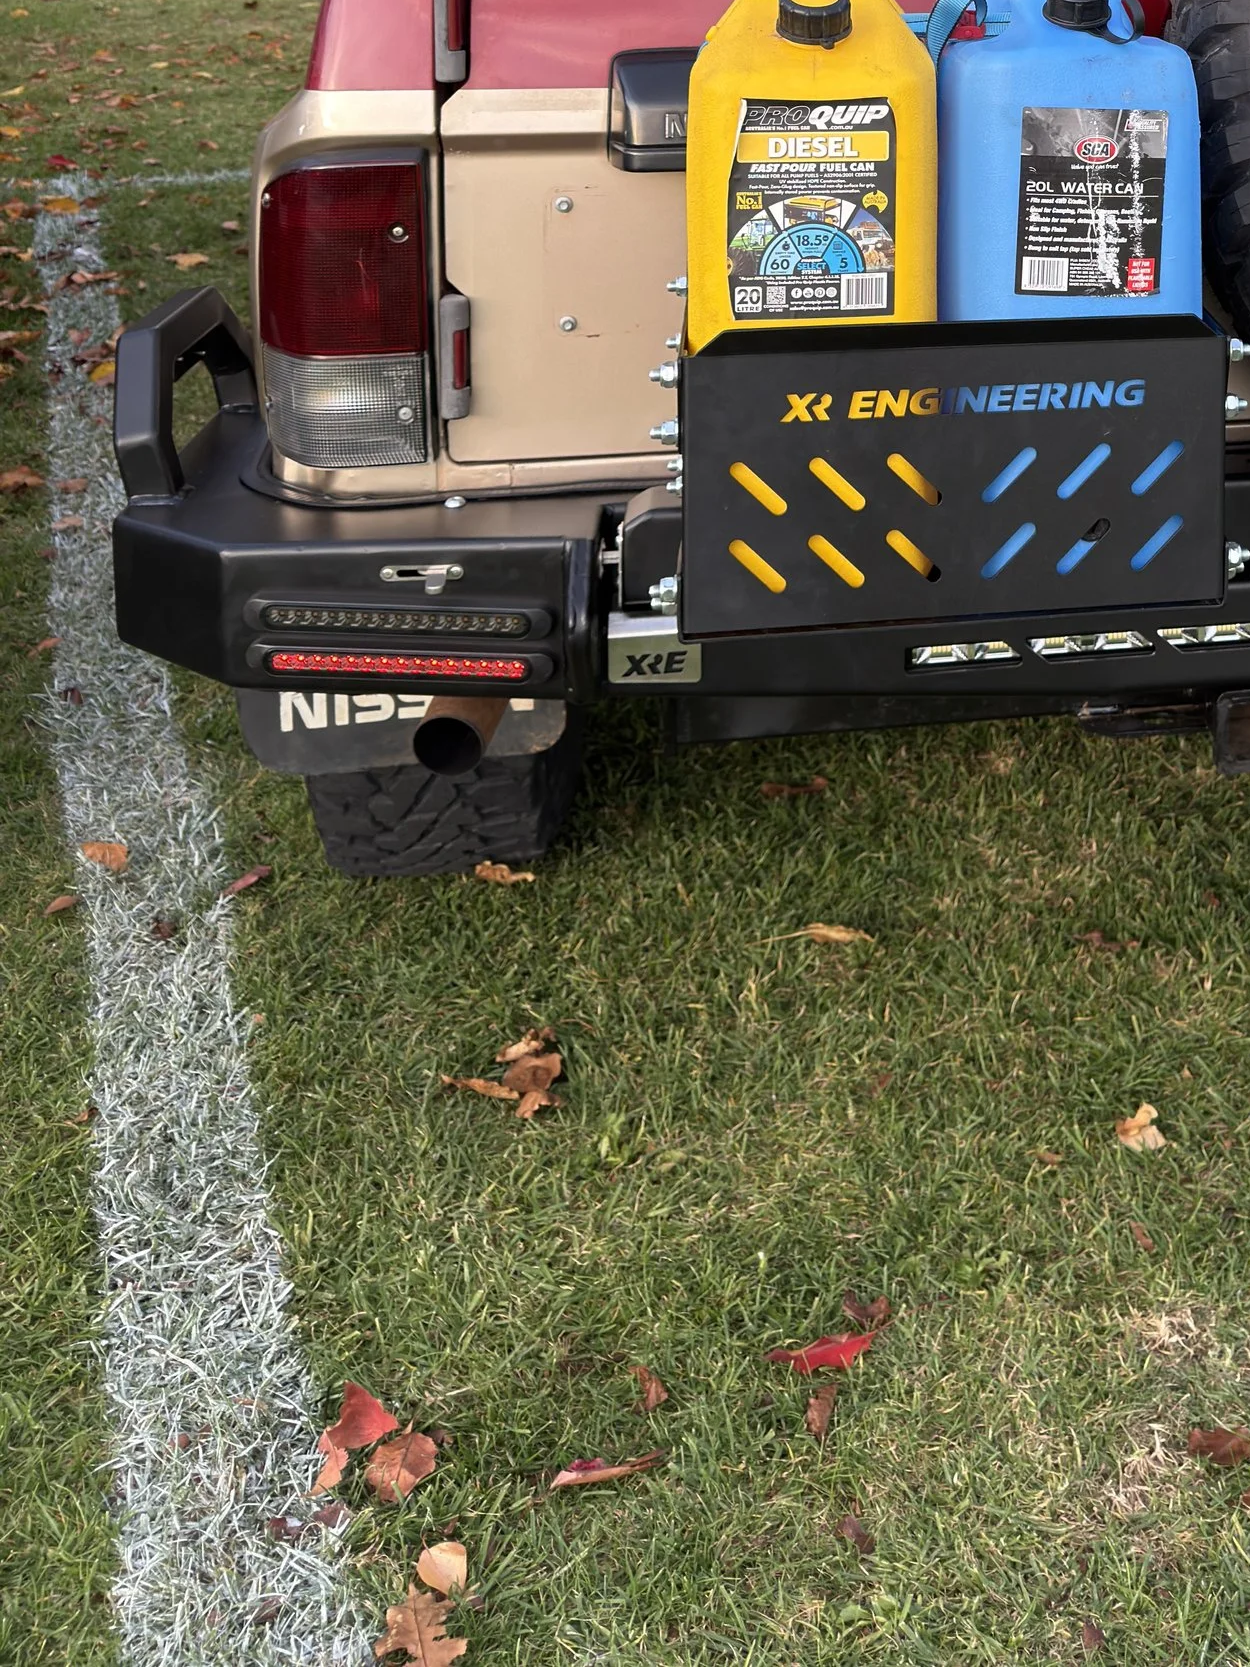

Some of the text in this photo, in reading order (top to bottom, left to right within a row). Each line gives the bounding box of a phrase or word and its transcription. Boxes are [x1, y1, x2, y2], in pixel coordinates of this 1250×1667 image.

[743, 105, 889, 130] PROQUIP
[768, 136, 859, 158] DIESEL
[1082, 141, 1110, 157] SCA
[750, 162, 875, 173] FAST POUR FUEL CAN
[1026, 181, 1144, 195] 20L WATER CAN
[737, 195, 763, 205] No.1
[770, 259, 790, 270] 60
[797, 262, 827, 270] SELECT
[839, 257, 849, 269] 5
[736, 288, 761, 305] 20
[780, 379, 1145, 423] XR ENGINEERING
[621, 650, 688, 677] XRE
[279, 691, 535, 732] NISS
